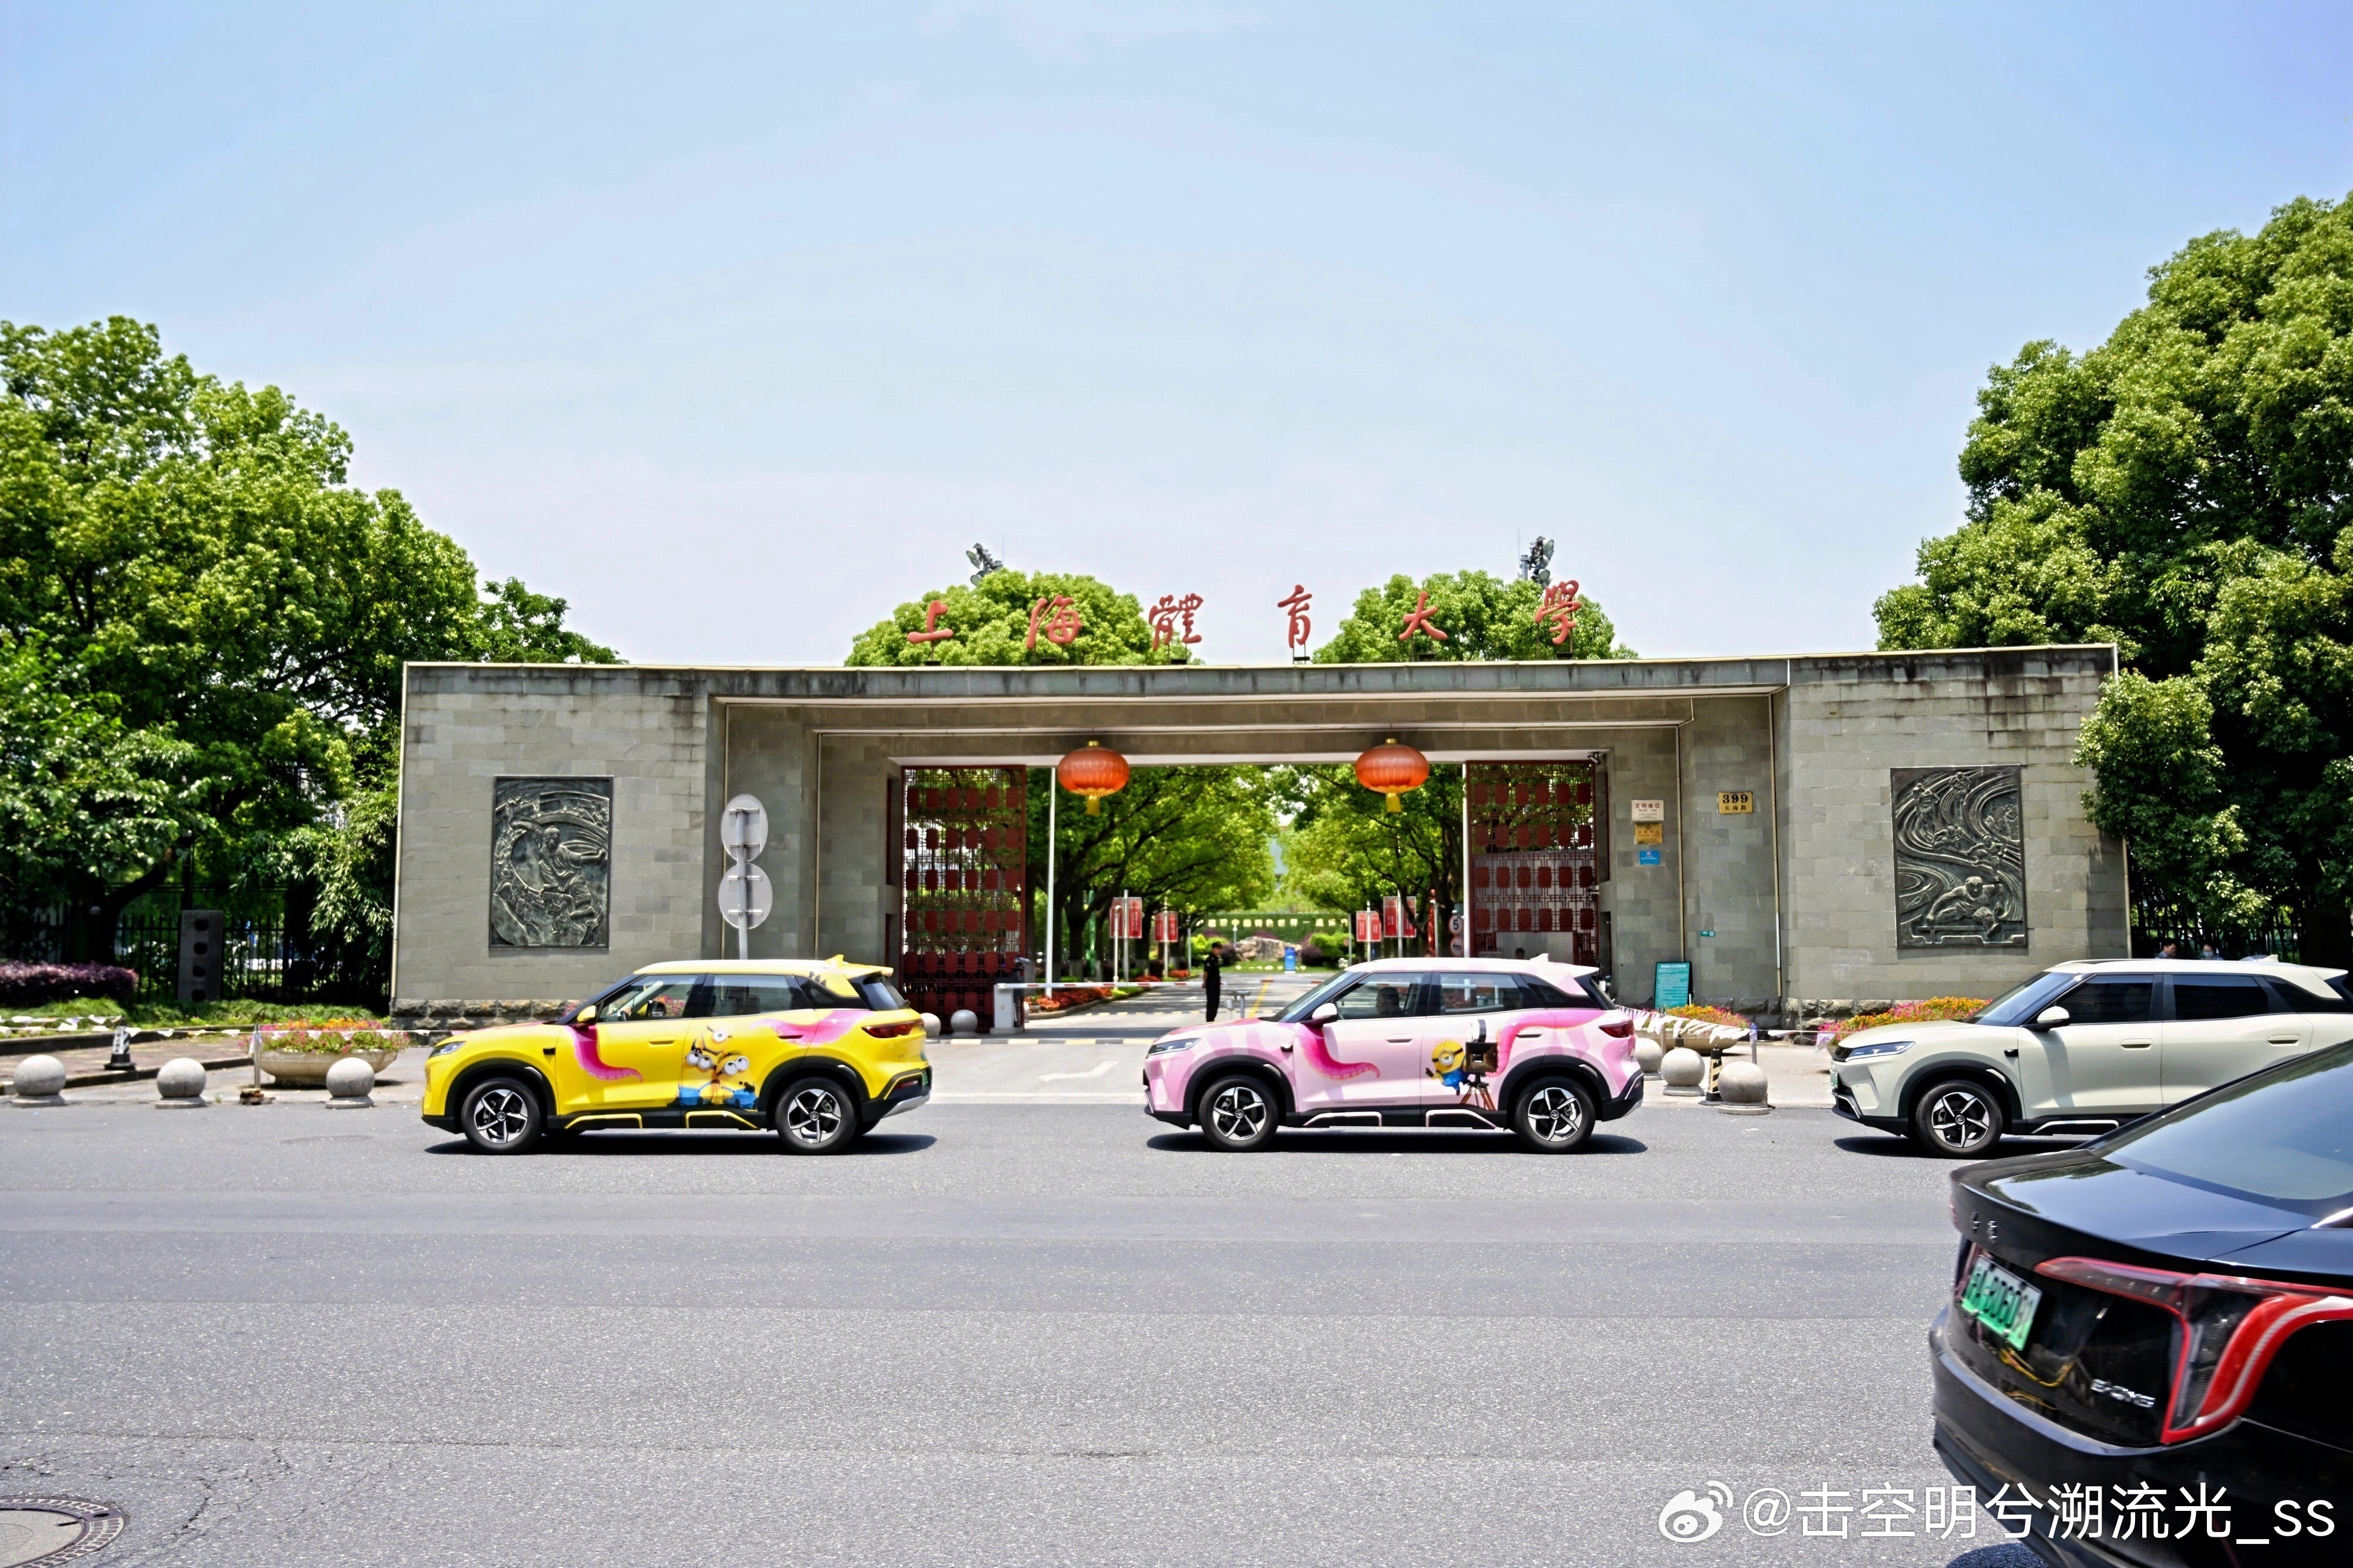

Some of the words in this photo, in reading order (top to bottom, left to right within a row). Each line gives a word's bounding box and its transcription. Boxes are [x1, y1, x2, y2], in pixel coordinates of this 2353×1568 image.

[907, 579, 1581, 651] 上海體育大學
[1722, 794, 1748, 804] 399
[1453, 919, 1459, 930] 5
